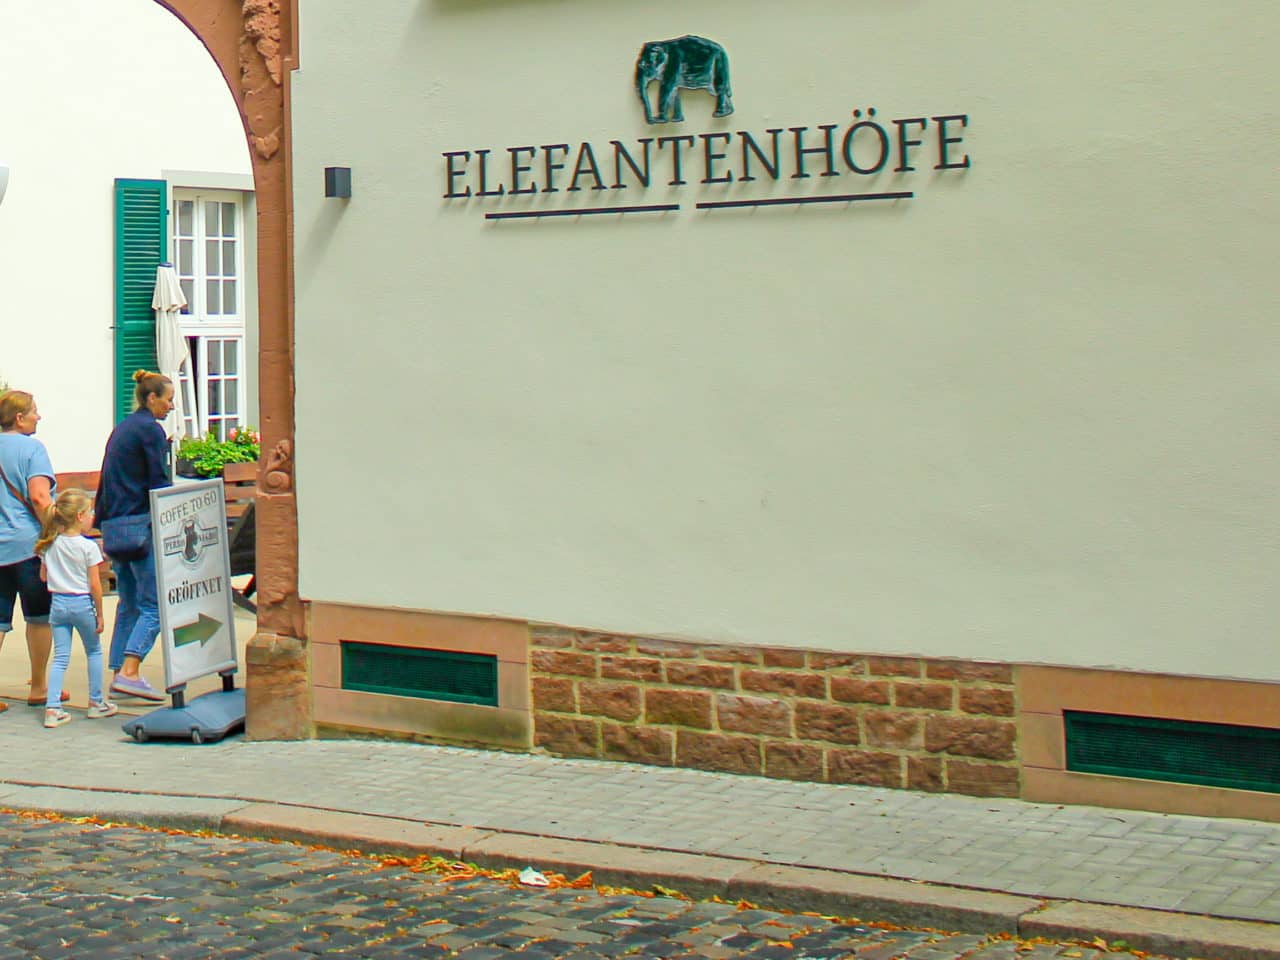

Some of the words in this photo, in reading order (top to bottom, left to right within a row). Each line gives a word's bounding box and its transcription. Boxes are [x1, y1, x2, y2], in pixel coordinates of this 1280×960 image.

[442, 108, 970, 199] ELEFANTENHÖFE
[160, 502, 189, 526] COFFE
[191, 496, 203, 513] TO
[168, 576, 222, 606] GEÖFFNET
